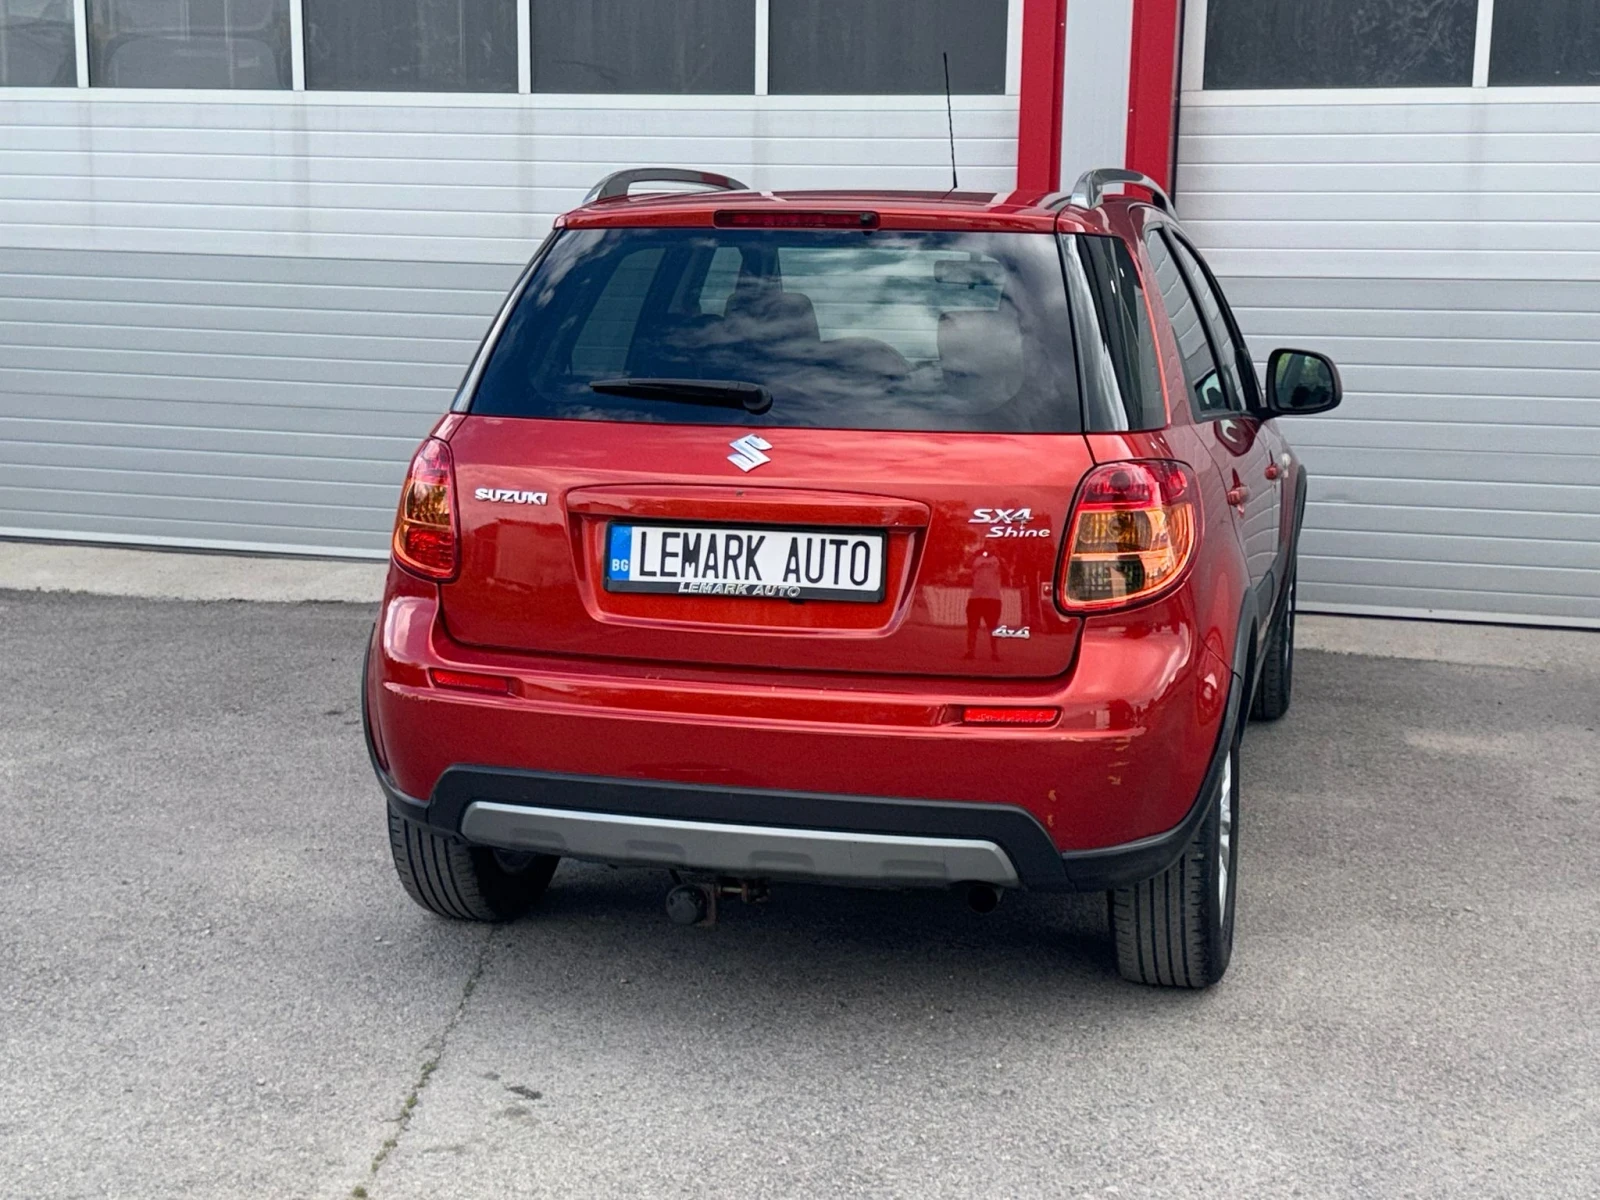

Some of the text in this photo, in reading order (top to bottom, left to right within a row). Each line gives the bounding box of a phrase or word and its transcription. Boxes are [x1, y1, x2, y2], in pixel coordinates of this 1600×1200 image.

[475, 488, 548, 506] SUZUKI
[968, 508, 1034, 524] SX4
[985, 526, 1051, 538] Shine
[611, 558, 629, 572] BG
[639, 531, 871, 586] LEMARK AUTO
[678, 582, 801, 598] LEMARK AUTO
